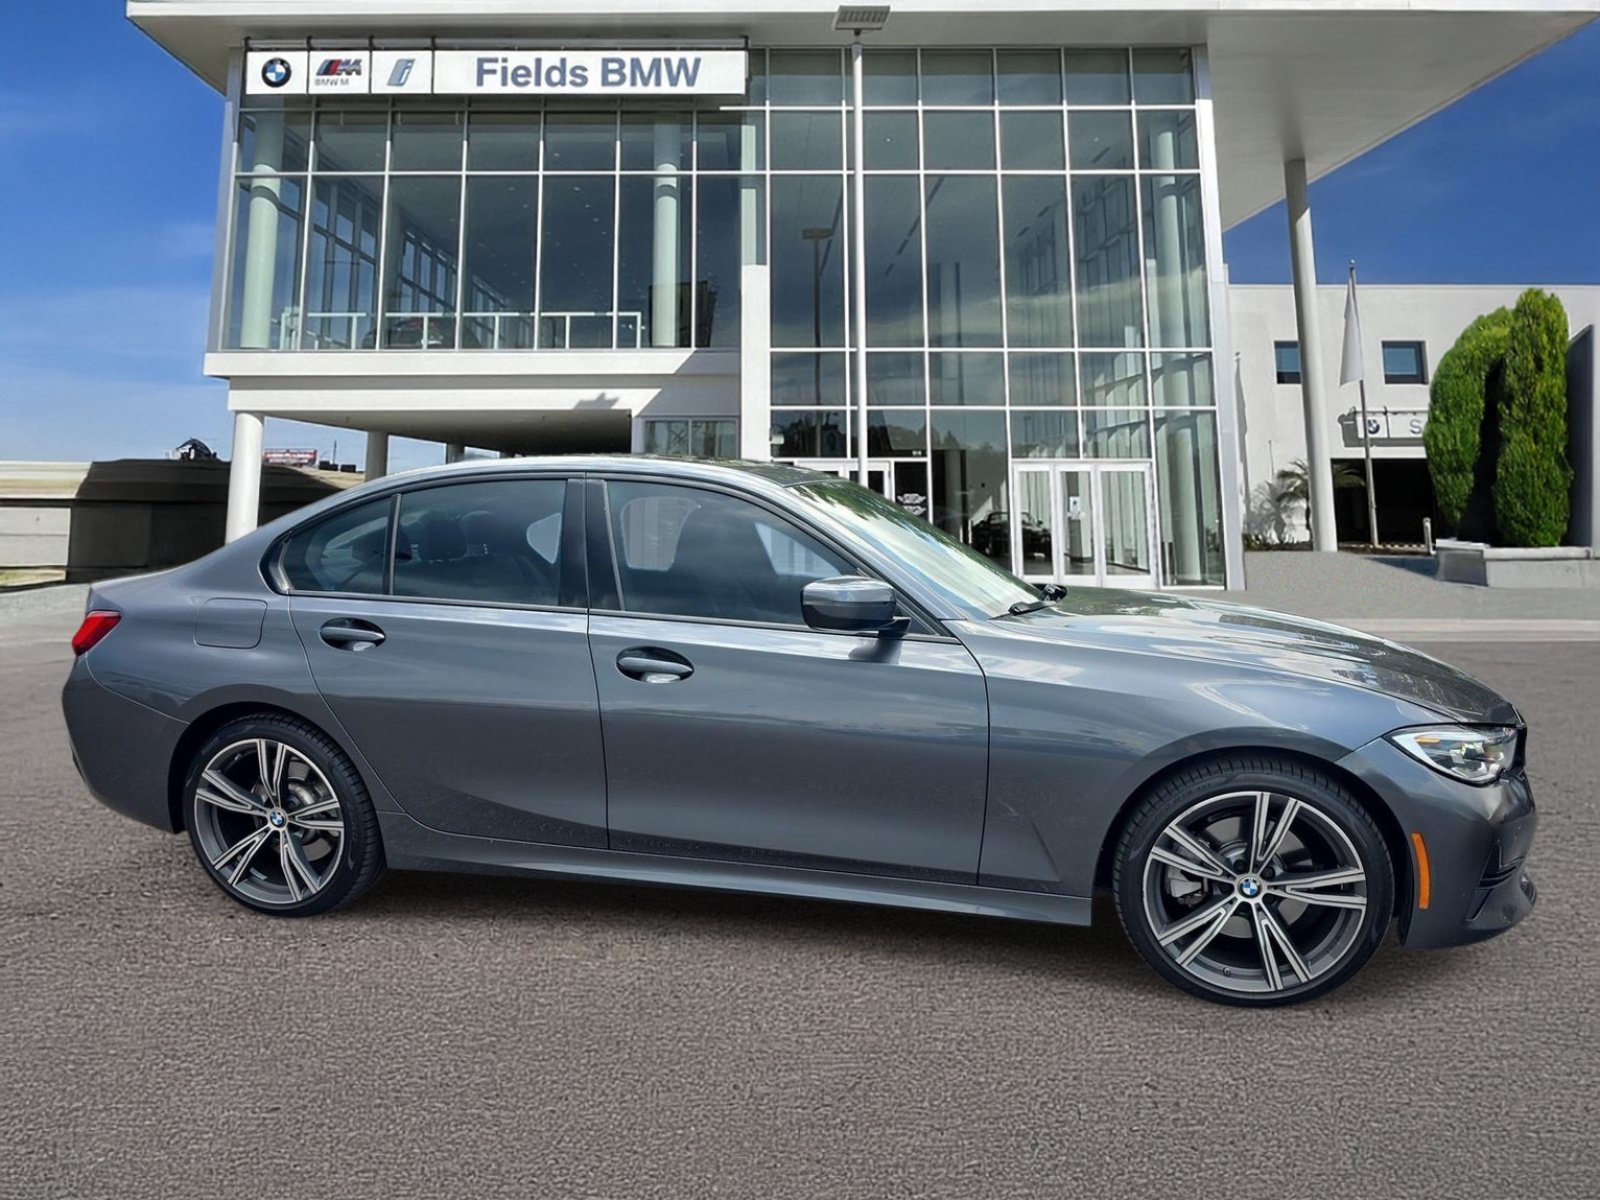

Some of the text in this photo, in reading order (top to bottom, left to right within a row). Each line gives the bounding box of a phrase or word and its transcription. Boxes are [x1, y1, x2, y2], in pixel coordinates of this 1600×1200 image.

[476, 57, 702, 87] Fields BMW
[315, 78, 339, 86] BMW
